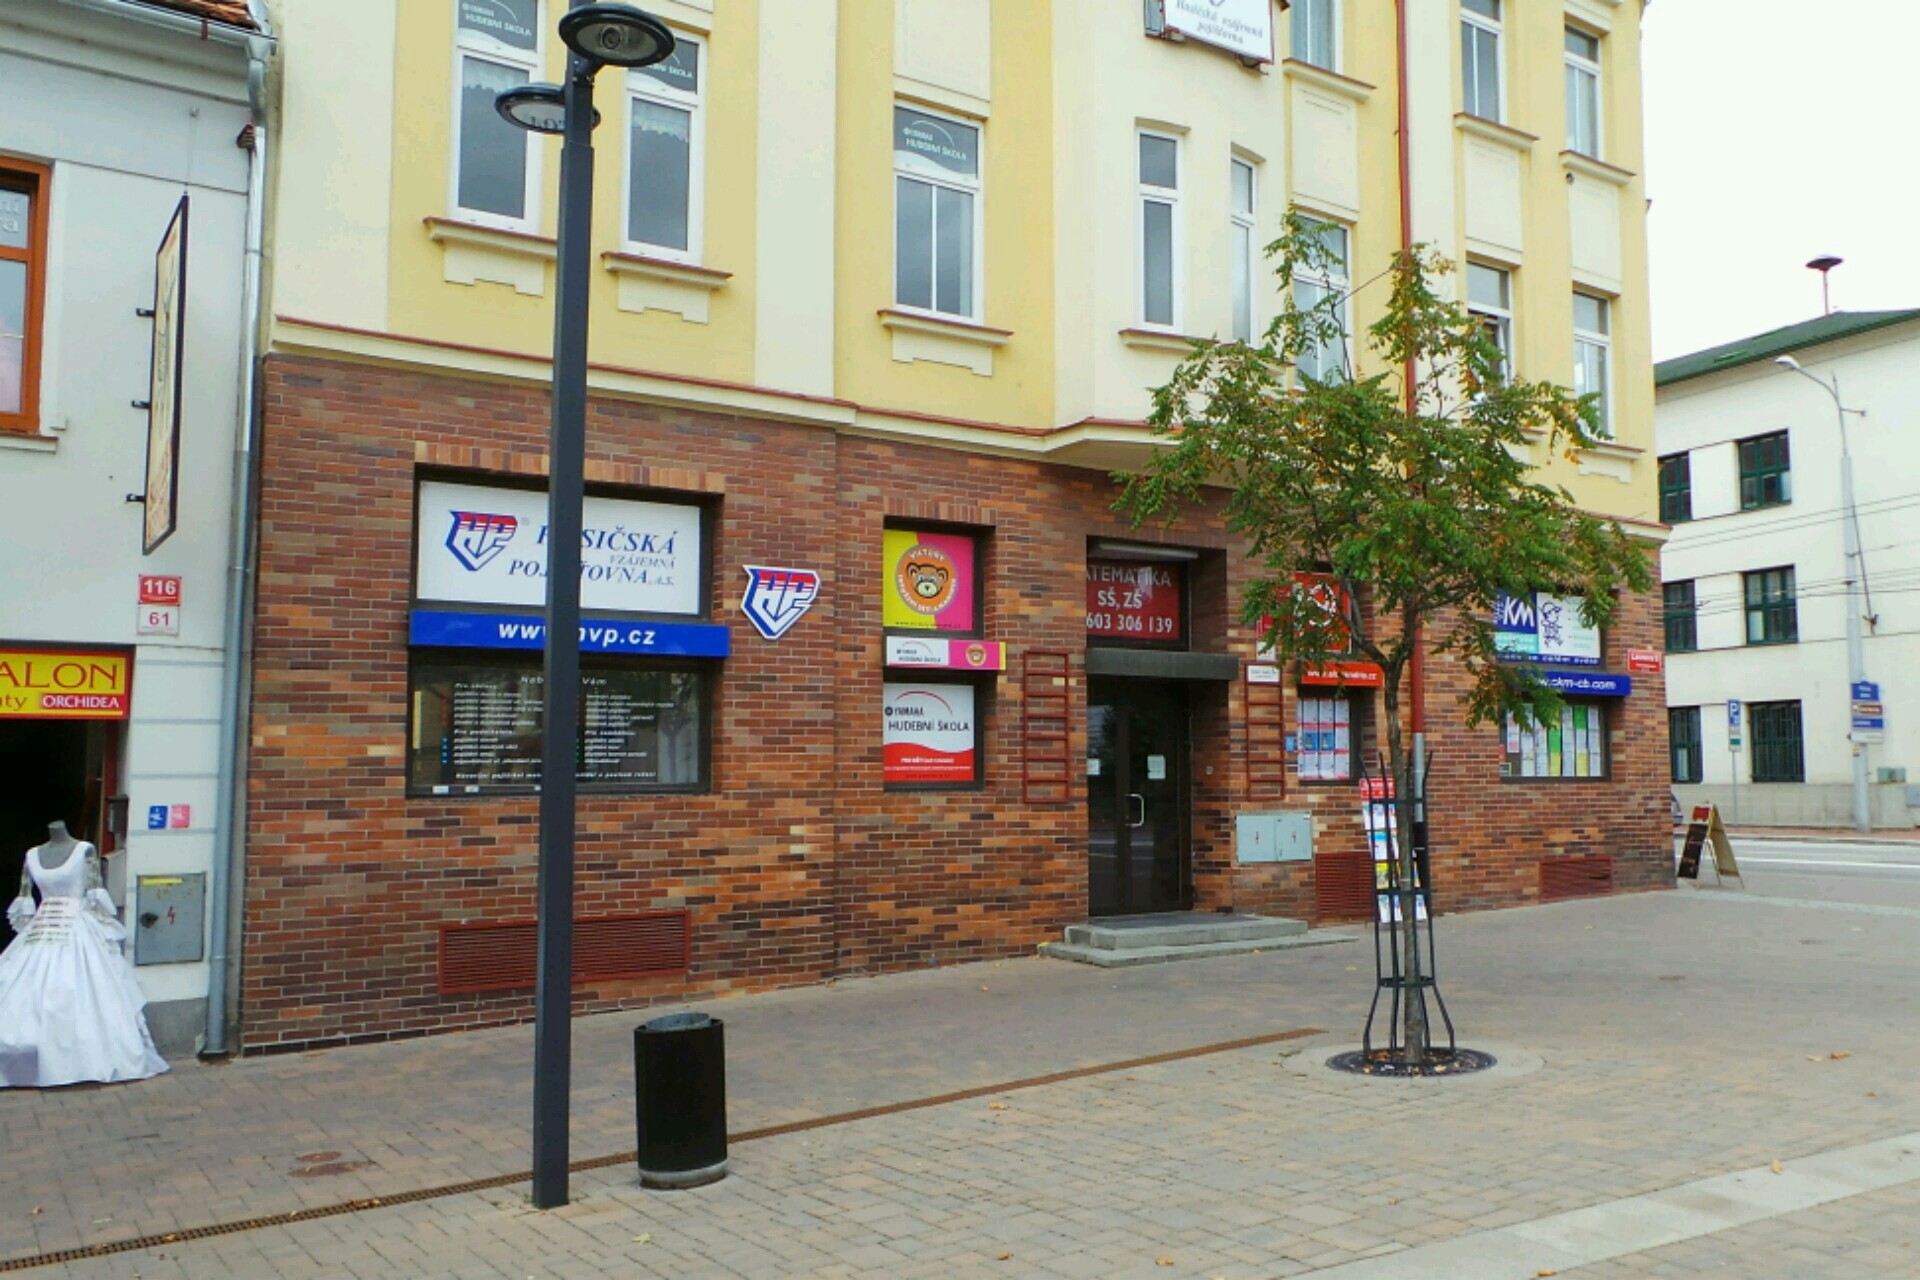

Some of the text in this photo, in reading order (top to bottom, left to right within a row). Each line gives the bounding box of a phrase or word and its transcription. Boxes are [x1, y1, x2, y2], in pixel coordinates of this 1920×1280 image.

[536, 525, 678, 555] SIČSKÁ
[1086, 565, 1171, 588] TEMATIKA
[143, 578, 177, 595] 116
[1123, 588, 1143, 609] ZŠ
[149, 611, 169, 626] 61
[1086, 612, 1173, 634] 603 306 139
[43, 694, 119, 708] ORCHIDEA
[888, 718, 971, 732] HUDEBNÍ ŠKOLA
